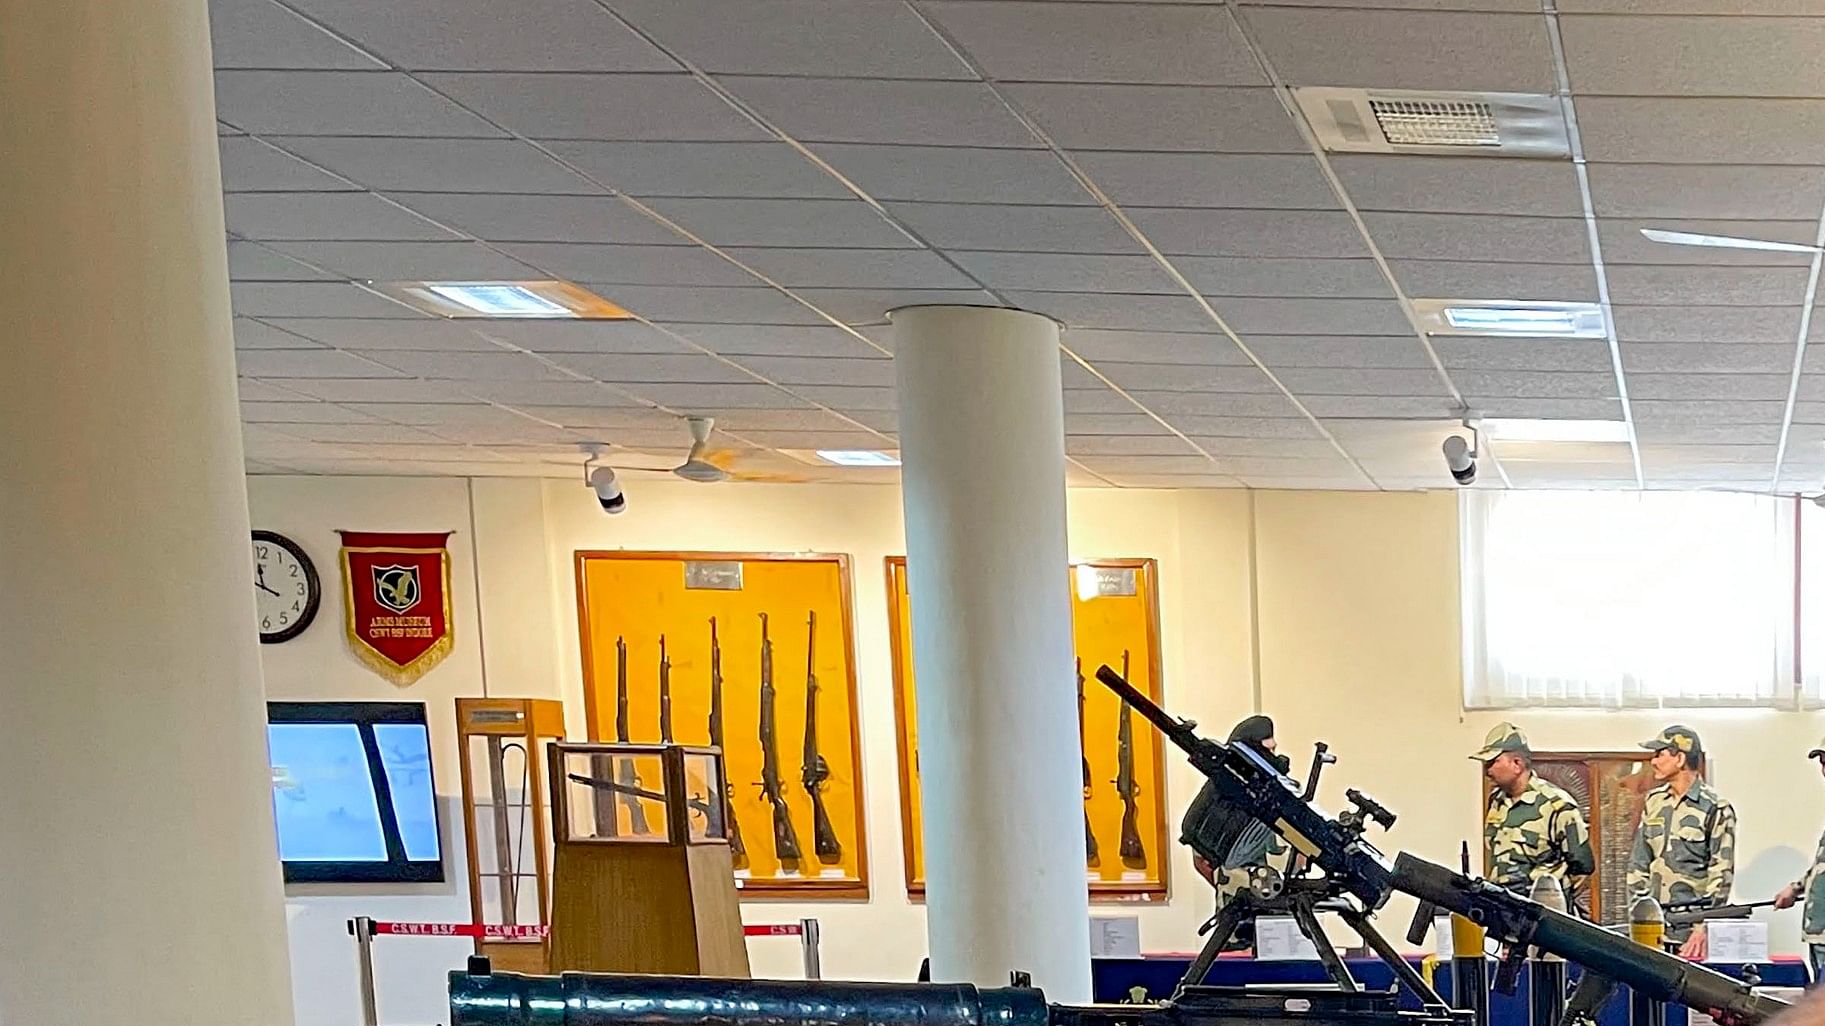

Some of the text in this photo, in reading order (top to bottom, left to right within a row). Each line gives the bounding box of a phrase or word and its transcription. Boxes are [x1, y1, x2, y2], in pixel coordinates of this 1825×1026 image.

[256, 546, 268, 560] 12
[277, 551, 282, 563] 1
[289, 564, 298, 577] 2
[296, 582, 305, 596] 3
[292, 599, 300, 612] 4
[262, 616, 271, 629] 6
[280, 612, 288, 625] 5
[525, 925, 550, 937] B.S.F
